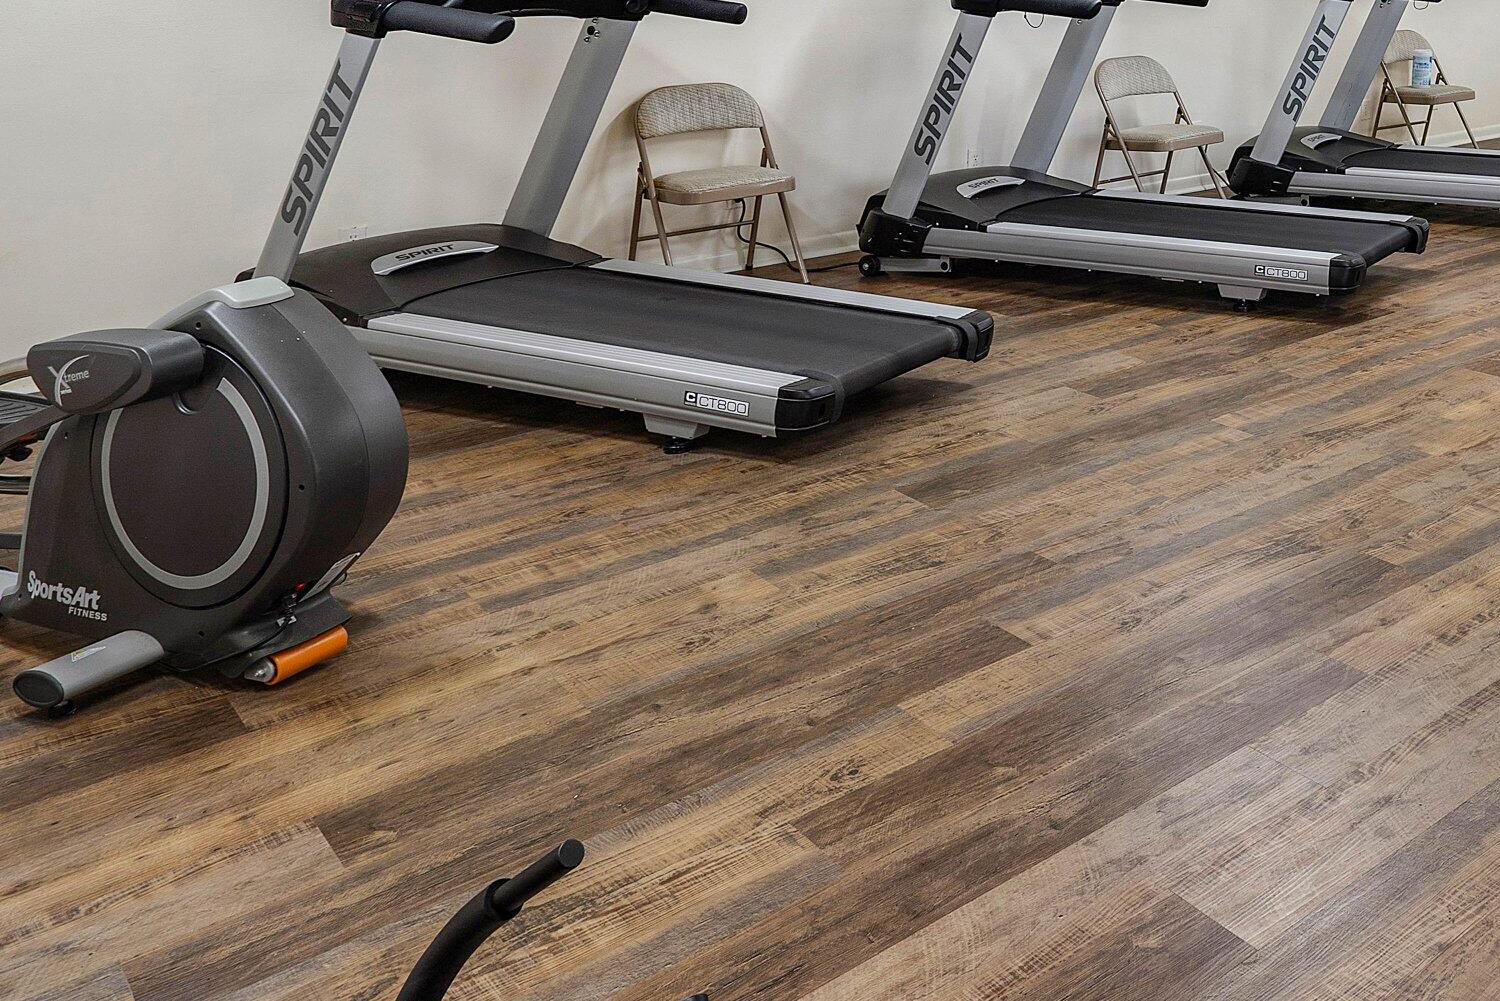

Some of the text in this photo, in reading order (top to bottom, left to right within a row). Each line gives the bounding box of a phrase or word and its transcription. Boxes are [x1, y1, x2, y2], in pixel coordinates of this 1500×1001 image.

[1283, 14, 1335, 122] SPIRIT
[914, 32, 973, 166] SPIRIT
[281, 57, 353, 236] SPIRIT
[395, 244, 454, 261] SPIRIT
[1266, 267, 1306, 279] CT800
[699, 396, 747, 414] CT800
[27, 570, 101, 610] SportsArt
[68, 606, 108, 621] FITNESS
